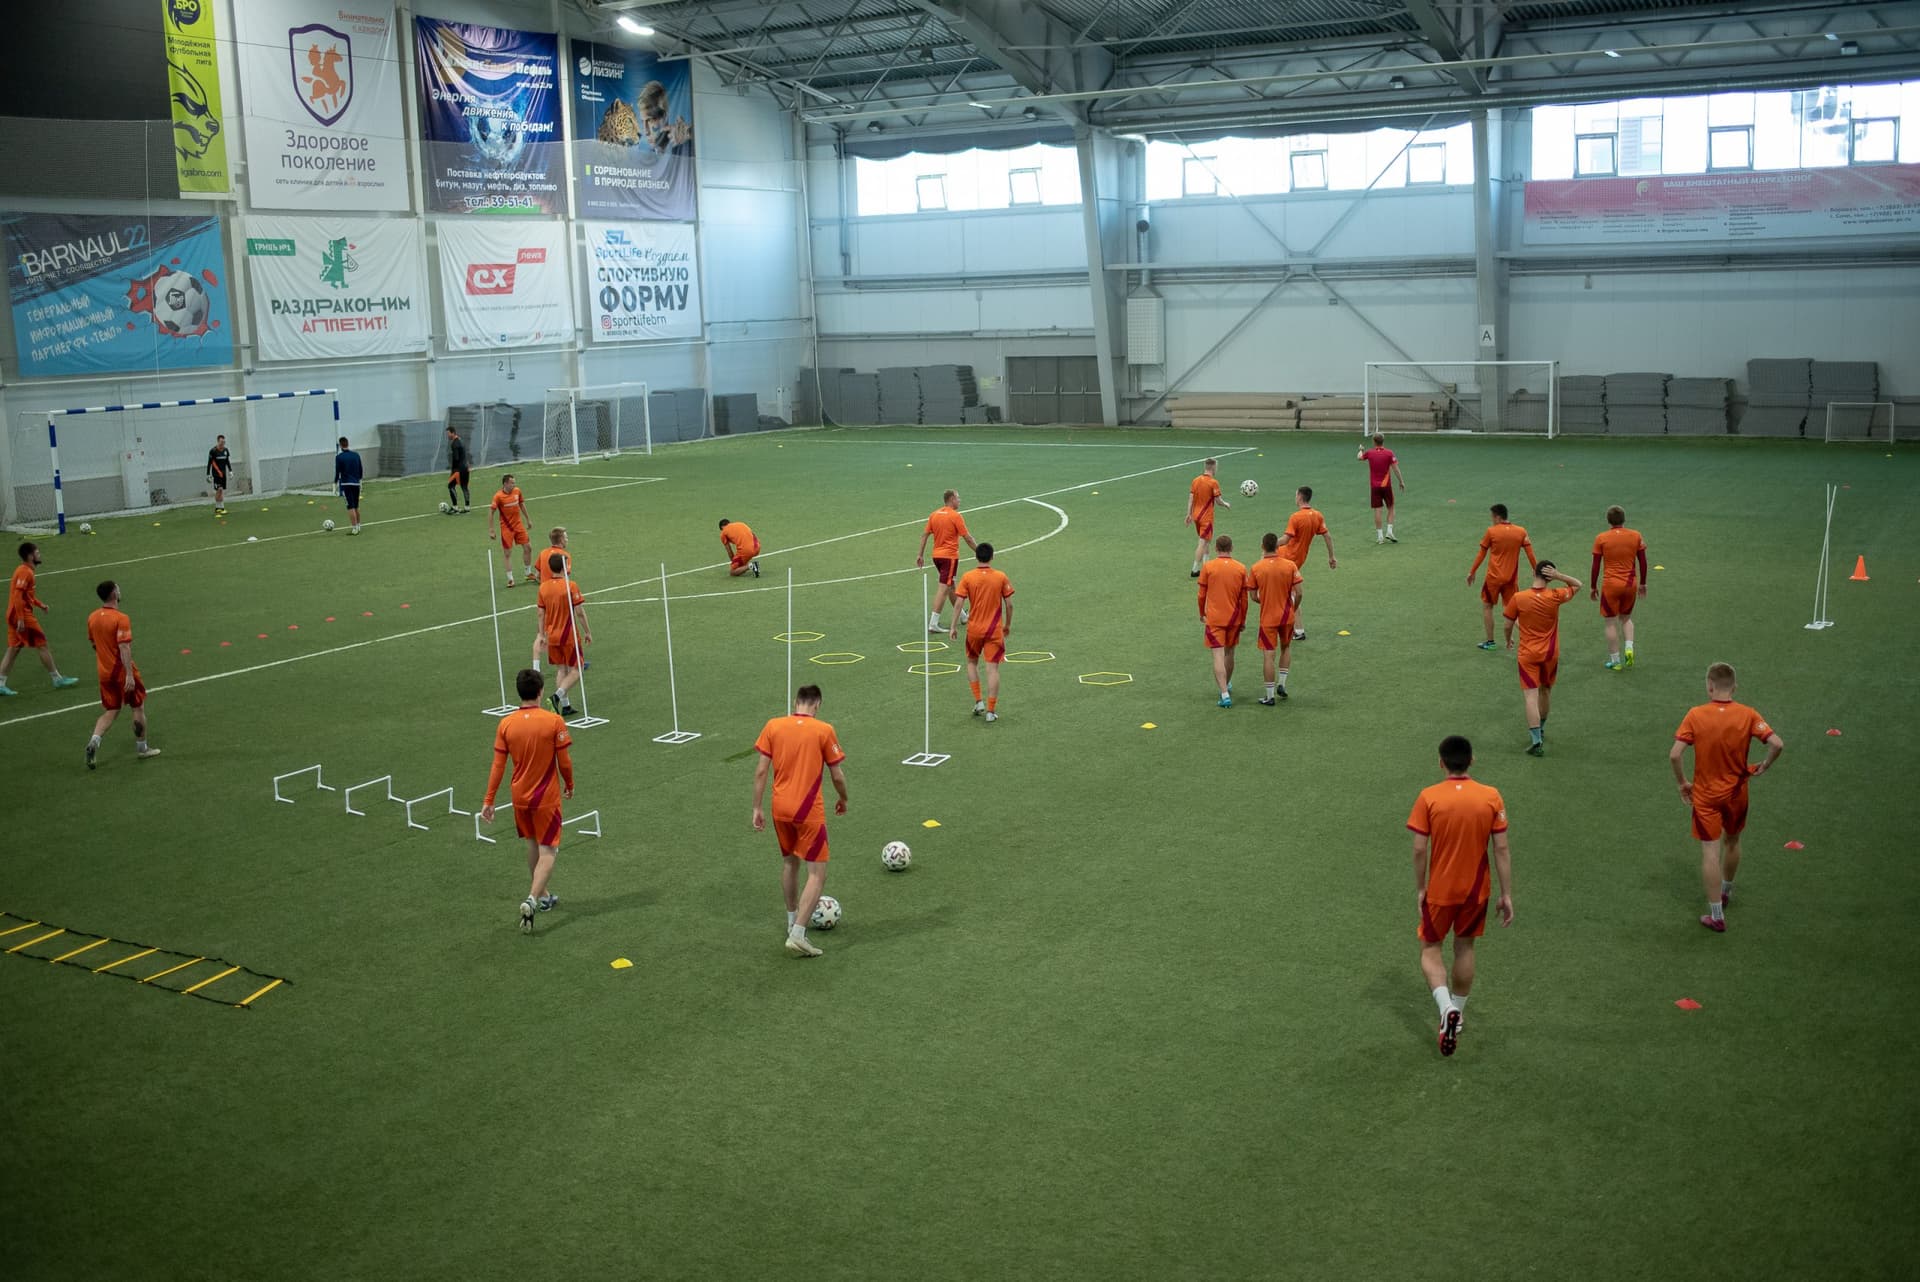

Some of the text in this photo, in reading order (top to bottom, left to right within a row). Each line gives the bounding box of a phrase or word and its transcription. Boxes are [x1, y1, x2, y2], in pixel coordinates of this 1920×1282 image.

[285, 130, 369, 151] Здоровое
[281, 155, 376, 171] поколение
[447, 168, 482, 178] Поставка
[594, 166, 652, 178] СОРЕВНОВАНИЕ
[594, 177, 670, 190] В ПРИРОДЕ БИЗНЕСА
[598, 267, 689, 283] СПОРТИВНУЮ
[271, 296, 410, 316] РАЗДРАКОНИМ
[599, 284, 689, 313] ФОРМУ
[27, 294, 89, 323] ГЕНЕРАЛЬНЫЙ
[30, 306, 115, 344] ИНФОРМАЦИОННЫЙ
[302, 316, 388, 333] АППЕТИТ!
[32, 340, 72, 362] ПАРТНЕР
[73, 336, 88, 349] ФК
[497, 360, 505, 372] 2
